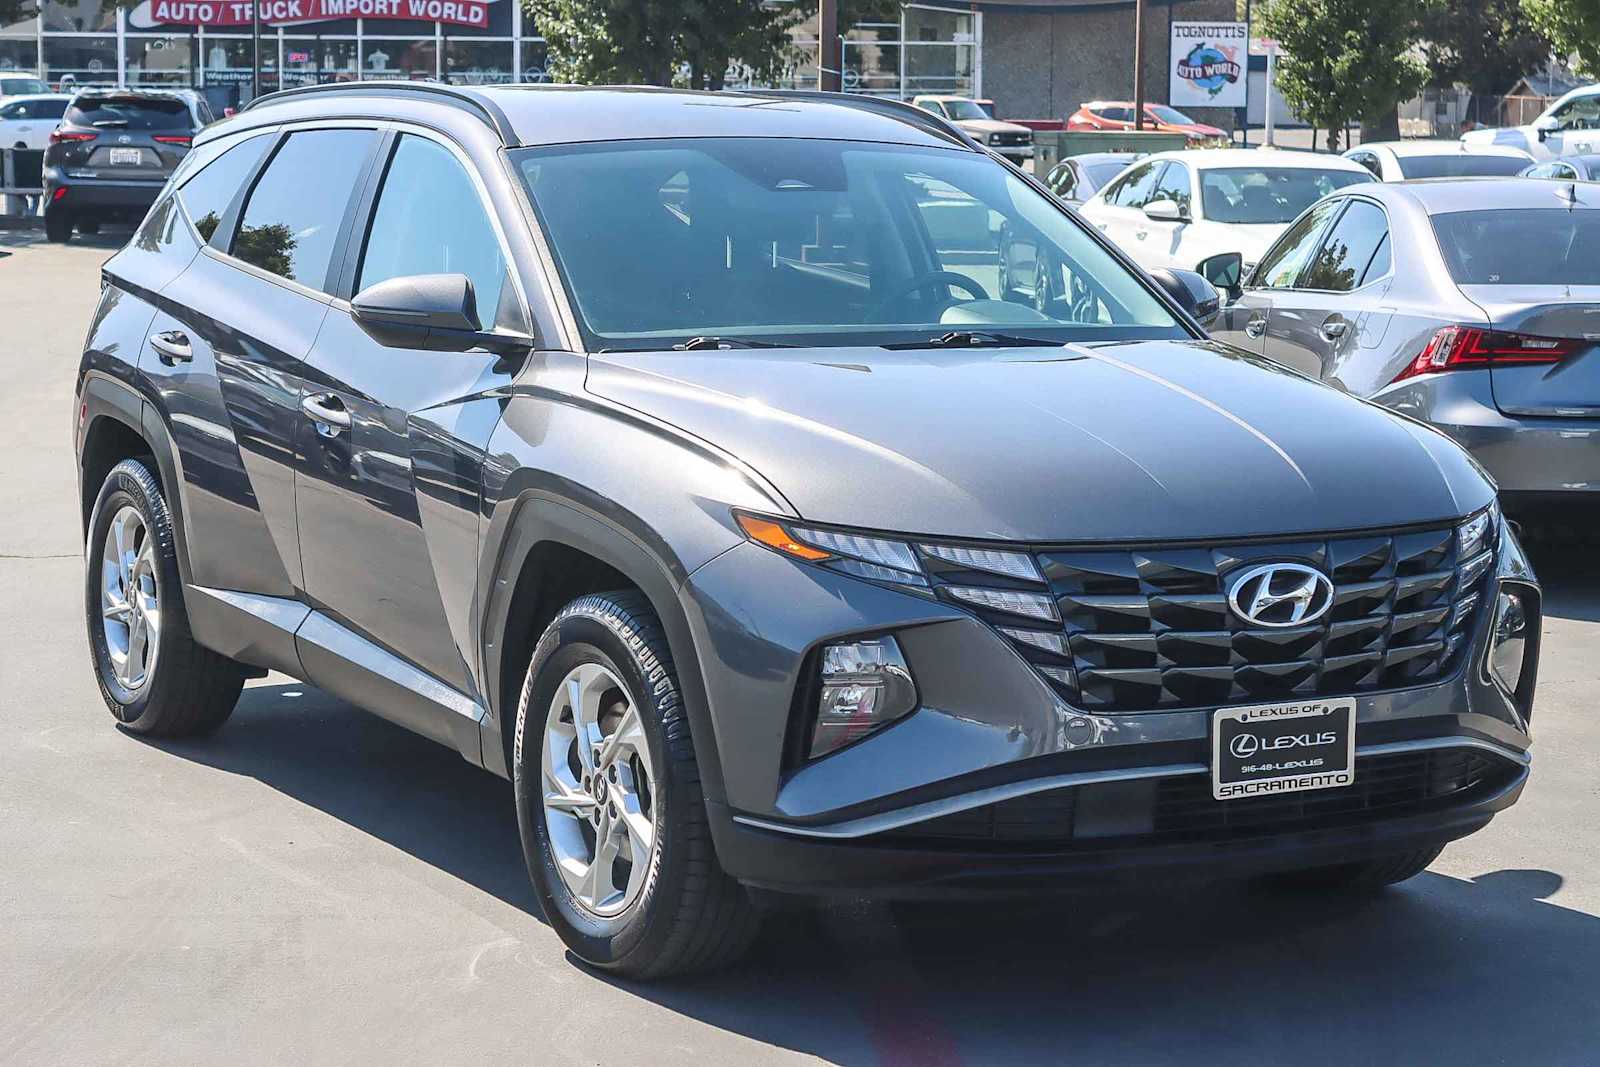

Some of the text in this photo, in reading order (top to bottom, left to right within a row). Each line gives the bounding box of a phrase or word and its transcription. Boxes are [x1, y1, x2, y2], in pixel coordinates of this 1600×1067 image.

[155, 1, 213, 22] AUTO
[320, 0, 401, 15] IMPORT
[408, 0, 484, 23] WORLD
[1204, 62, 1239, 77] WORLD
[1249, 704, 1322, 718] LEXUS OF
[1261, 731, 1337, 750] LEXUS
[1241, 758, 1324, 774] 916-48-LEXUS
[1219, 774, 1349, 797] SACRAMENTO
